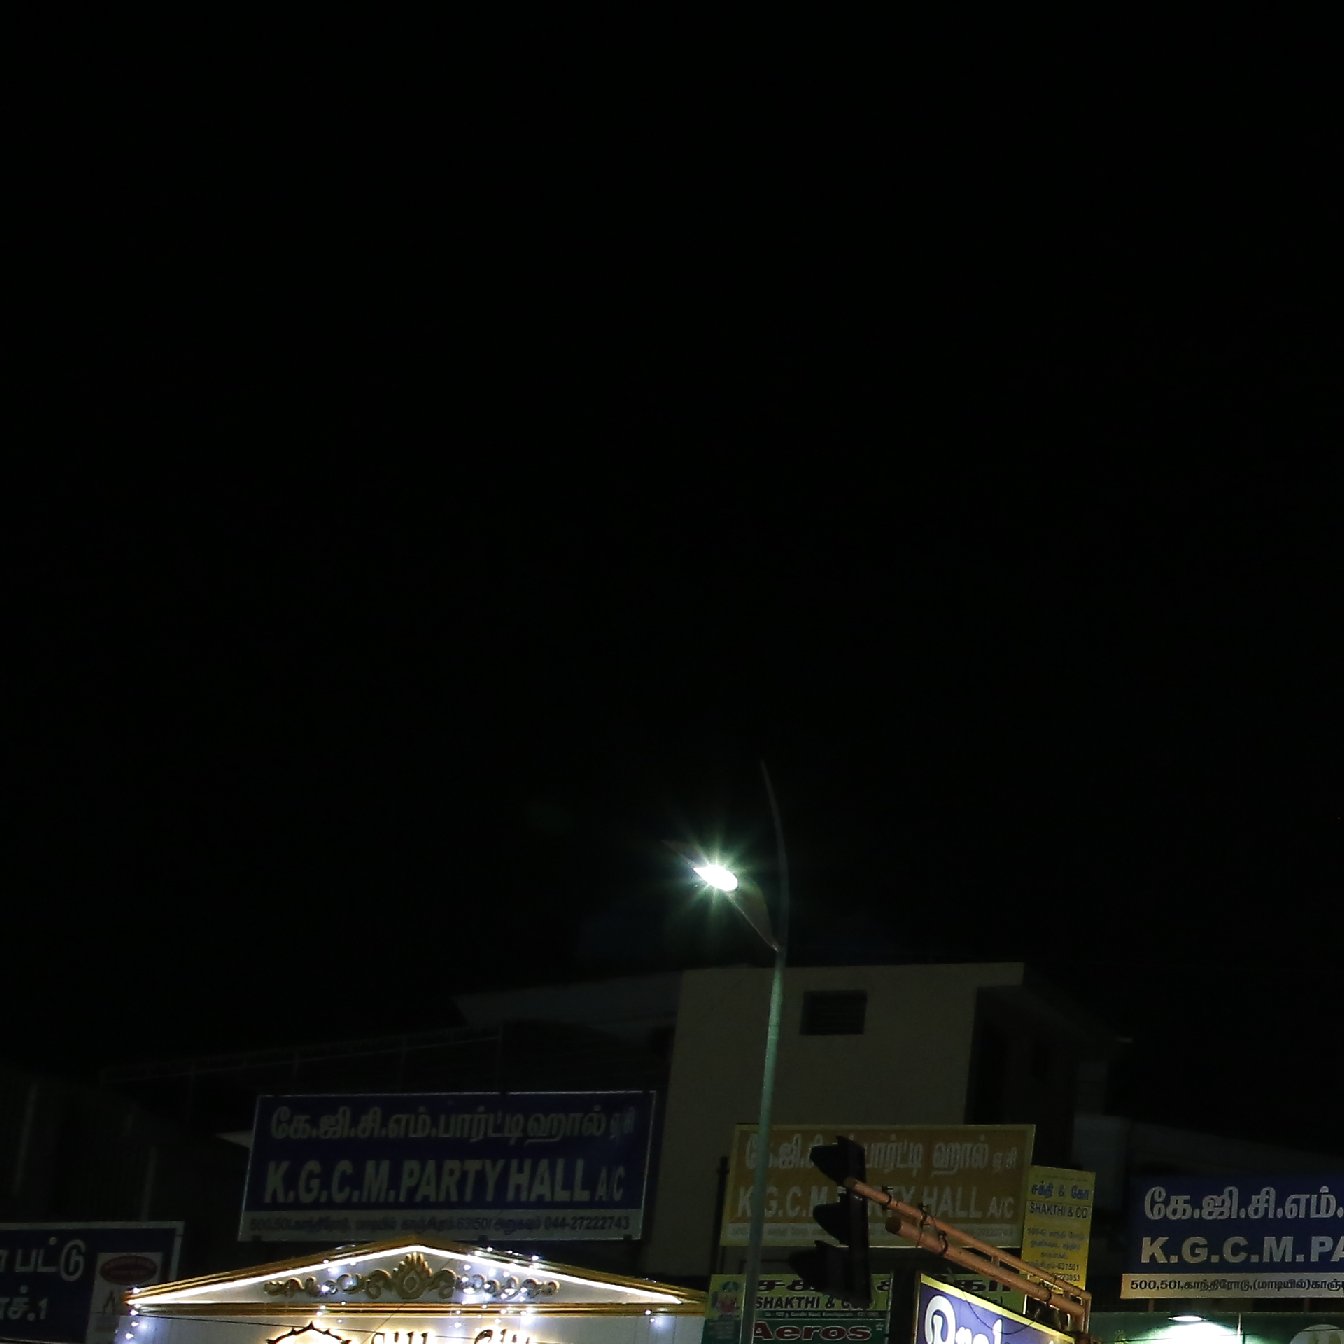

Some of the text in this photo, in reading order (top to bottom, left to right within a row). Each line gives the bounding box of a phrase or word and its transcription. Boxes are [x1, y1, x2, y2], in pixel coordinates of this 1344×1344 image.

[507, 1158, 592, 1201] HALL
[825, 1296, 838, 1310] &
[752, 1320, 873, 1342] Aeros
